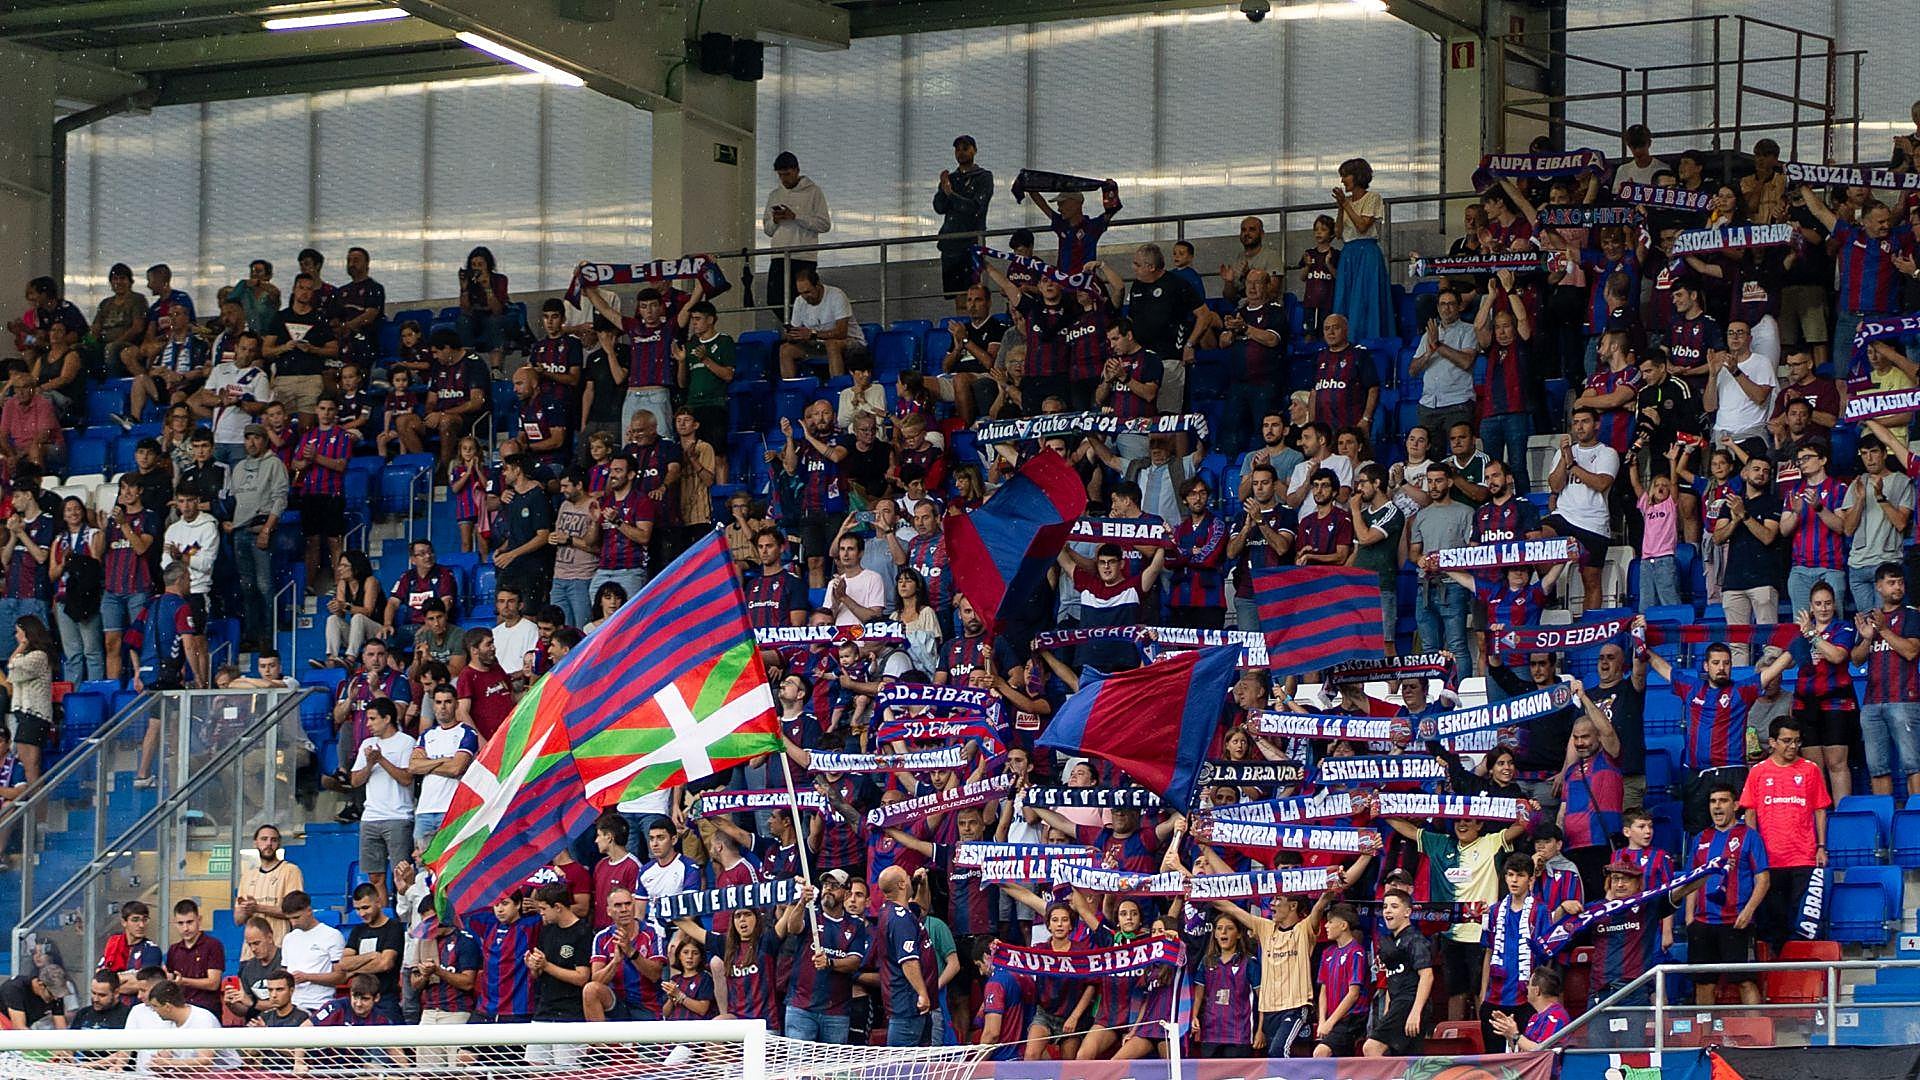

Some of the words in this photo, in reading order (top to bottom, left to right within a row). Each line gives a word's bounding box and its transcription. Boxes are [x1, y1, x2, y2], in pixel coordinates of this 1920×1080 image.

[1489, 155, 1532, 172] AUPA
[1536, 154, 1582, 171] EIBAR
[1787, 163, 1863, 185] SKOZIA
[1870, 167, 1896, 188] LA
[1675, 230, 1723, 252] SKOZIA
[1728, 227, 1746, 247] LA
[581, 265, 614, 282] SD
[1158, 416, 1178, 432] ON
[1102, 523, 1164, 539] EIBAR
[1439, 547, 1496, 568] ESKOZIA
[1502, 545, 1519, 563] LA
[1525, 540, 1568, 562] BRAVA
[754, 624, 832, 644] MAGINAK
[1203, 629, 1223, 646] LA
[1536, 632, 1561, 647] SD
[1565, 621, 1621, 646] EIBAR
[1405, 653, 1446, 667] BRAVA
[1437, 708, 1490, 735] ESKOZIA
[1492, 704, 1509, 725] LA
[1510, 691, 1552, 720] BRAVA
[902, 722, 925, 738] SD
[928, 720, 967, 738] Eibar
[1260, 713, 1319, 735] ESKOZIA
[1323, 717, 1342, 736] LA
[1346, 719, 1392, 739] BRAVA
[1213, 766, 1236, 781] LA
[1322, 759, 1380, 781] ESKOZIA
[1383, 759, 1400, 779] LA
[1403, 758, 1446, 778] BRAVA
[886, 793, 938, 817] ESKOZIA
[943, 788, 959, 803] LA
[1212, 801, 1276, 824] ESKOZIA
[1280, 799, 1300, 821] LA
[1305, 792, 1351, 818] BRAVA
[1379, 793, 1440, 815] ESKOZIA
[1445, 795, 1464, 815] LA
[1469, 796, 1518, 818] BRAVA
[1212, 821, 1277, 847] ESKOZIA
[1283, 827, 1303, 848] LA
[1309, 828, 1359, 851] BRAVA
[981, 860, 1025, 882] SKOZIA
[1030, 859, 1047, 879] LA
[1190, 875, 1253, 898] ESKOZIA
[1257, 873, 1278, 894] LA
[1282, 869, 1328, 891] BRAVA
[1803, 867, 1825, 920] BRAVA
[652, 878, 803, 917] OLVEREMOS
[1006, 949, 1077, 973] AUPA
